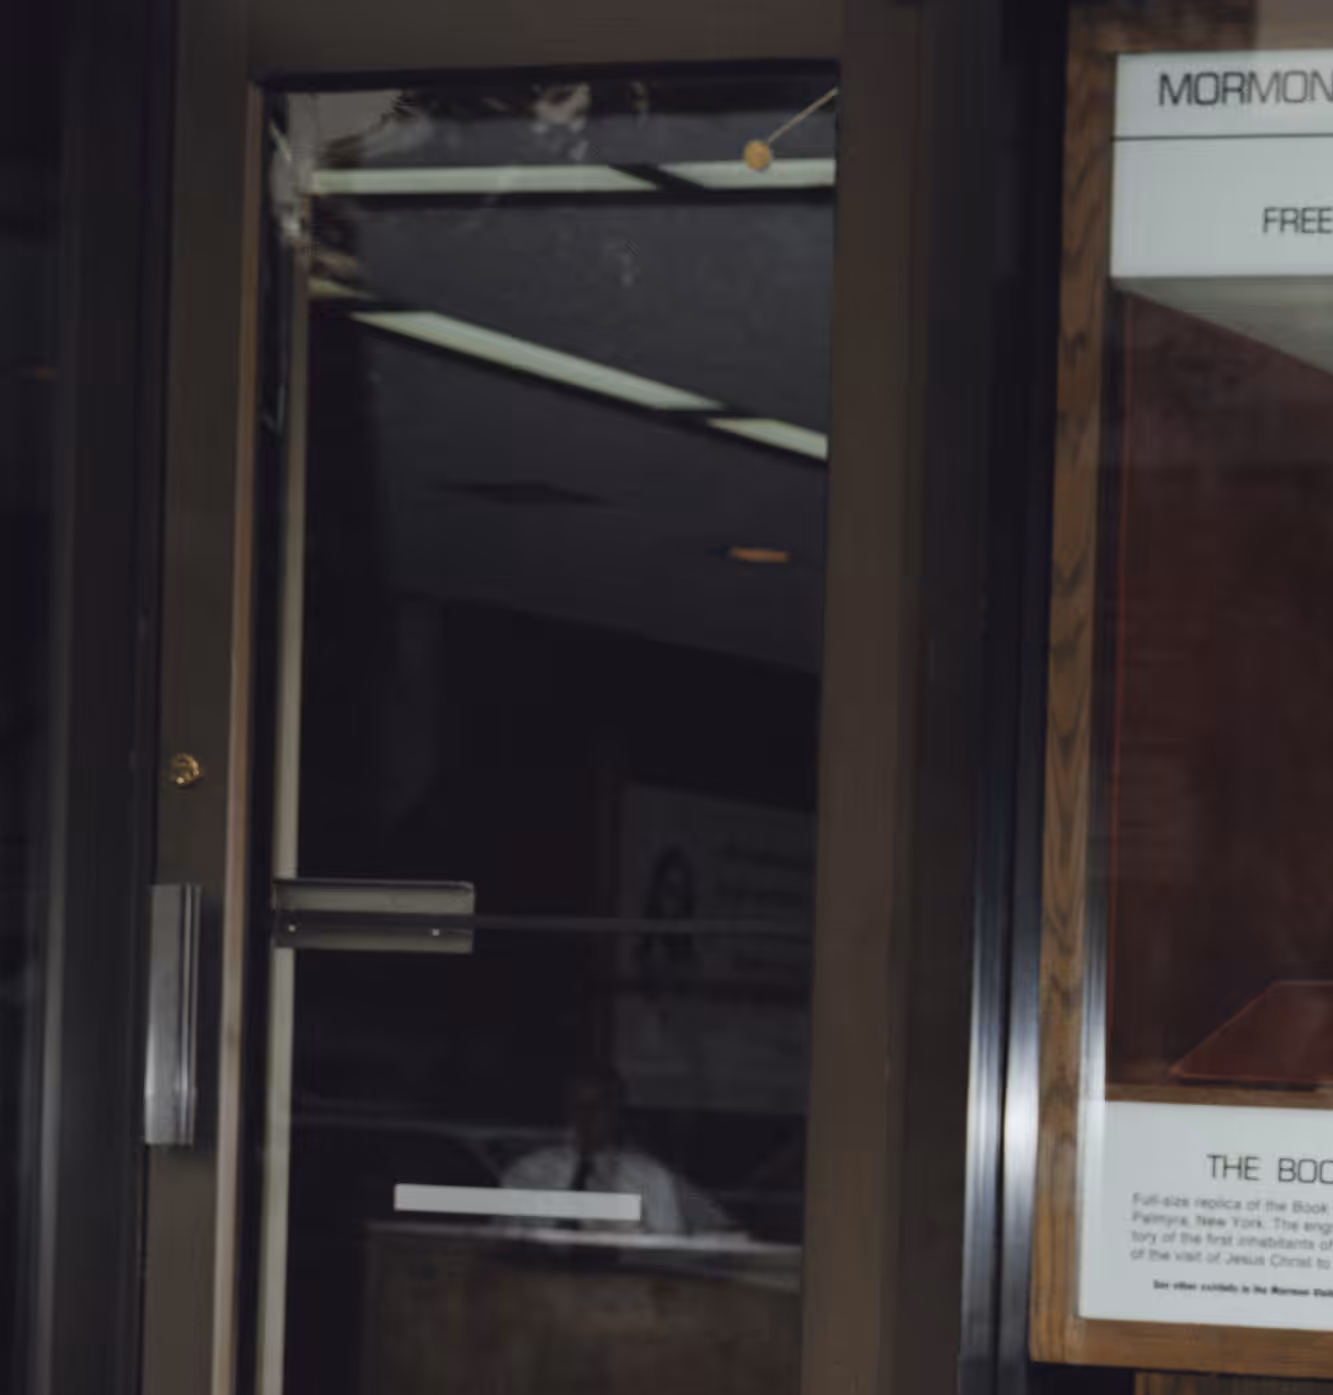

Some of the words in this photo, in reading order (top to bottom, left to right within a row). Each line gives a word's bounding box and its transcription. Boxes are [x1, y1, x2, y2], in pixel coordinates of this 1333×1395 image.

[1206, 1154, 1261, 1181] THE
[1246, 1199, 1261, 1211] of
[1265, 1199, 1287, 1212] the
[1292, 1200, 1327, 1214] Book
[1273, 1217, 1299, 1231] The
[1162, 1232, 1177, 1243] of
[1180, 1232, 1202, 1245] the
[1319, 1239, 1333, 1251] of
[1130, 1248, 1145, 1260] of
[1148, 1248, 1170, 1261] the
[1316, 1257, 1331, 1270] to
